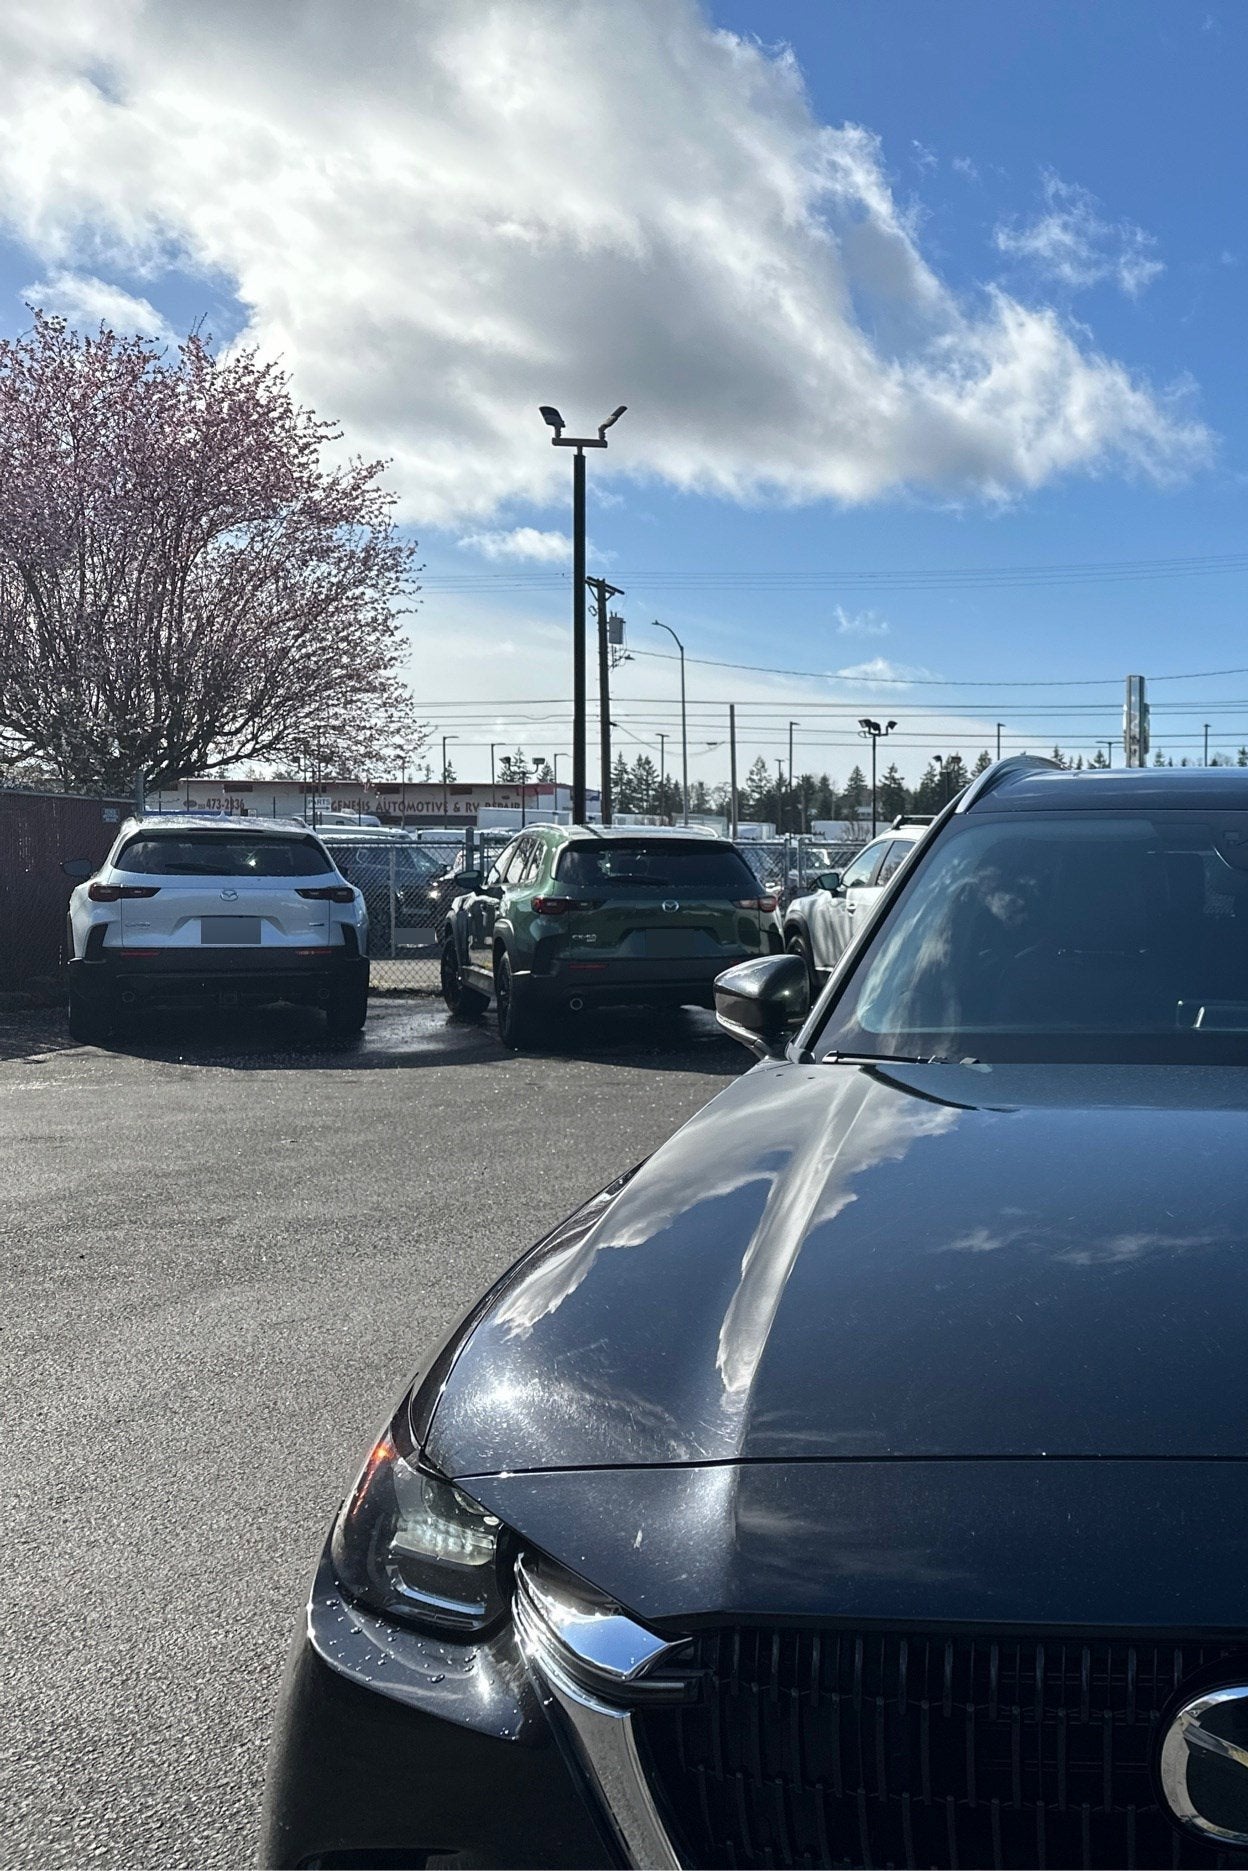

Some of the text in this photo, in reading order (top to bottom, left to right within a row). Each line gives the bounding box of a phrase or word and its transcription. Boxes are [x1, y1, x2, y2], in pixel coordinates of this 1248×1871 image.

[331, 800, 370, 810] GENESIS
[375, 801, 448, 812] AUTOMOTIVE
[453, 802, 460, 812] &
[466, 802, 480, 812] RV
